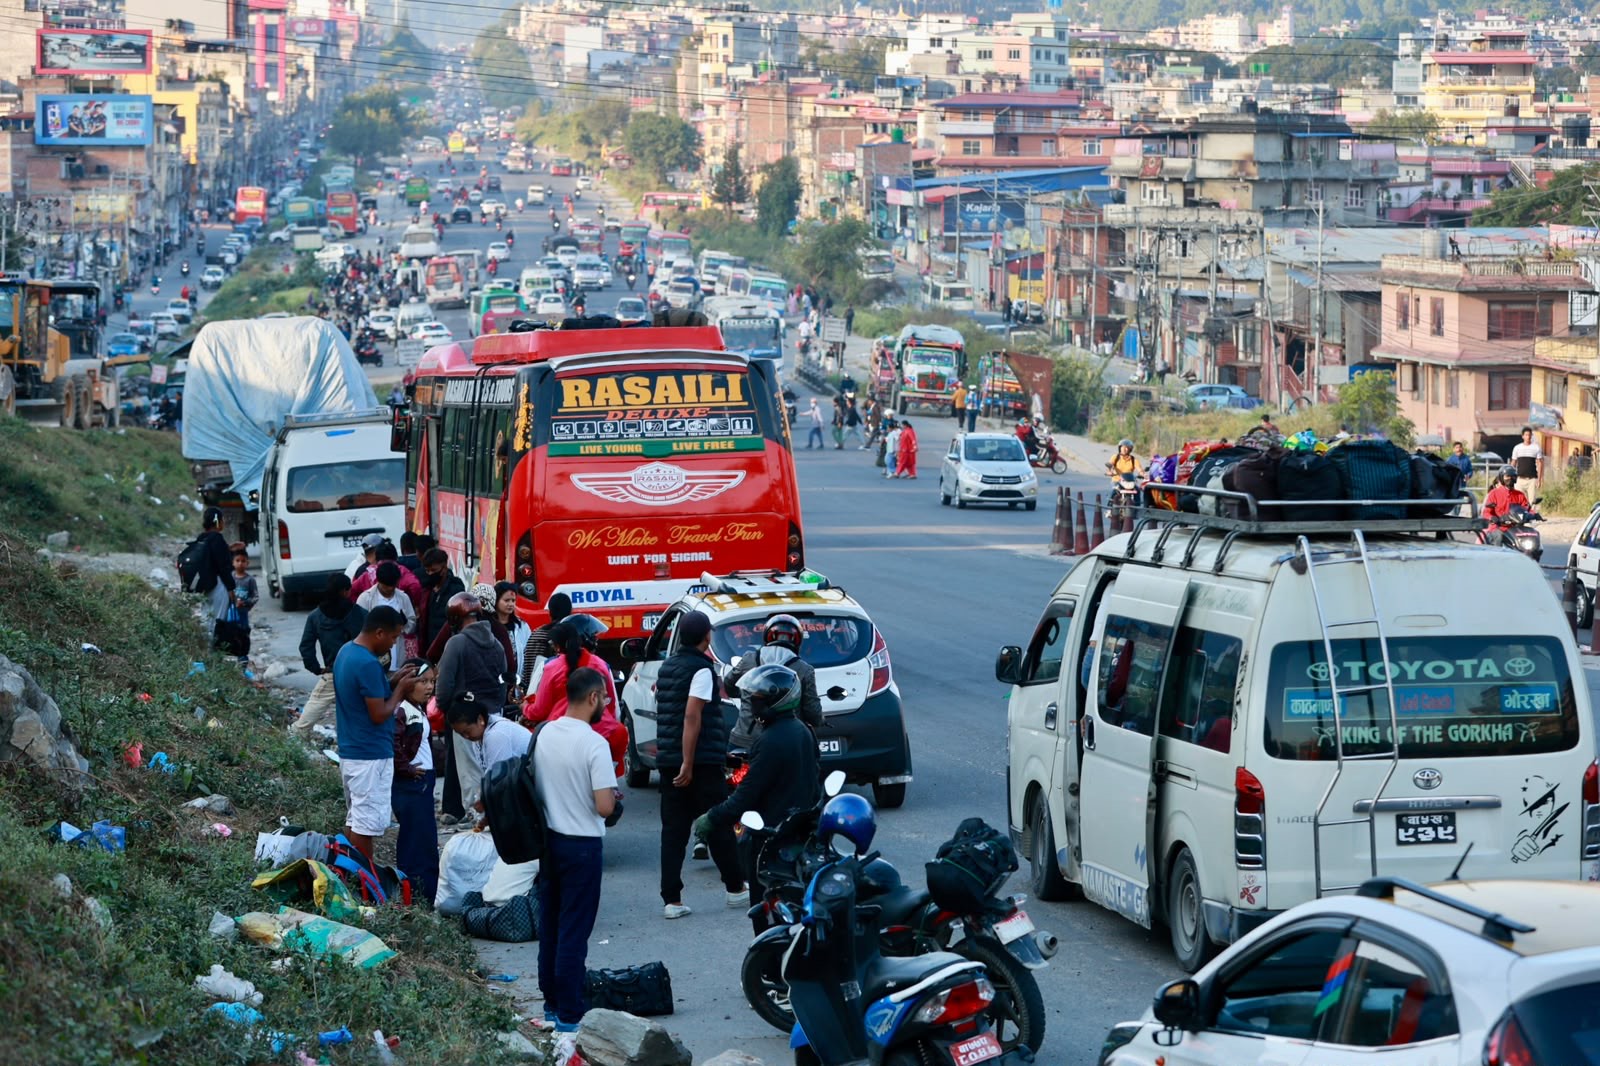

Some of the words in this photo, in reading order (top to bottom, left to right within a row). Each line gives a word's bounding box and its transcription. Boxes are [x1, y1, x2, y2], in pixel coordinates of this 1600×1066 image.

[305, 23, 318, 32] LG
[562, 374, 743, 407] RASAILI
[605, 408, 711, 421] DELUXE
[580, 446, 603, 454] LIVE
[605, 444, 643, 454] YOUNG
[672, 442, 701, 450] LIVE
[704, 440, 735, 450] FREE
[568, 528, 602, 549] We
[604, 527, 658, 548] Make
[667, 525, 722, 545] Travel
[723, 522, 764, 542] Fun
[607, 555, 638, 565] WAIT
[643, 553, 667, 563] FOR
[671, 552, 713, 562] SIGNAL
[571, 588, 635, 603] ROYAL
[1343, 658, 1500, 681] TOYOTA
[1503, 689, 1551, 709] गोरखा
[1341, 726, 1380, 744] KING
[1386, 726, 1407, 745] OF
[1411, 726, 1444, 744] THE
[1448, 723, 1513, 744] GORKHA
[1081, 864, 1127, 910] NAMASTE
